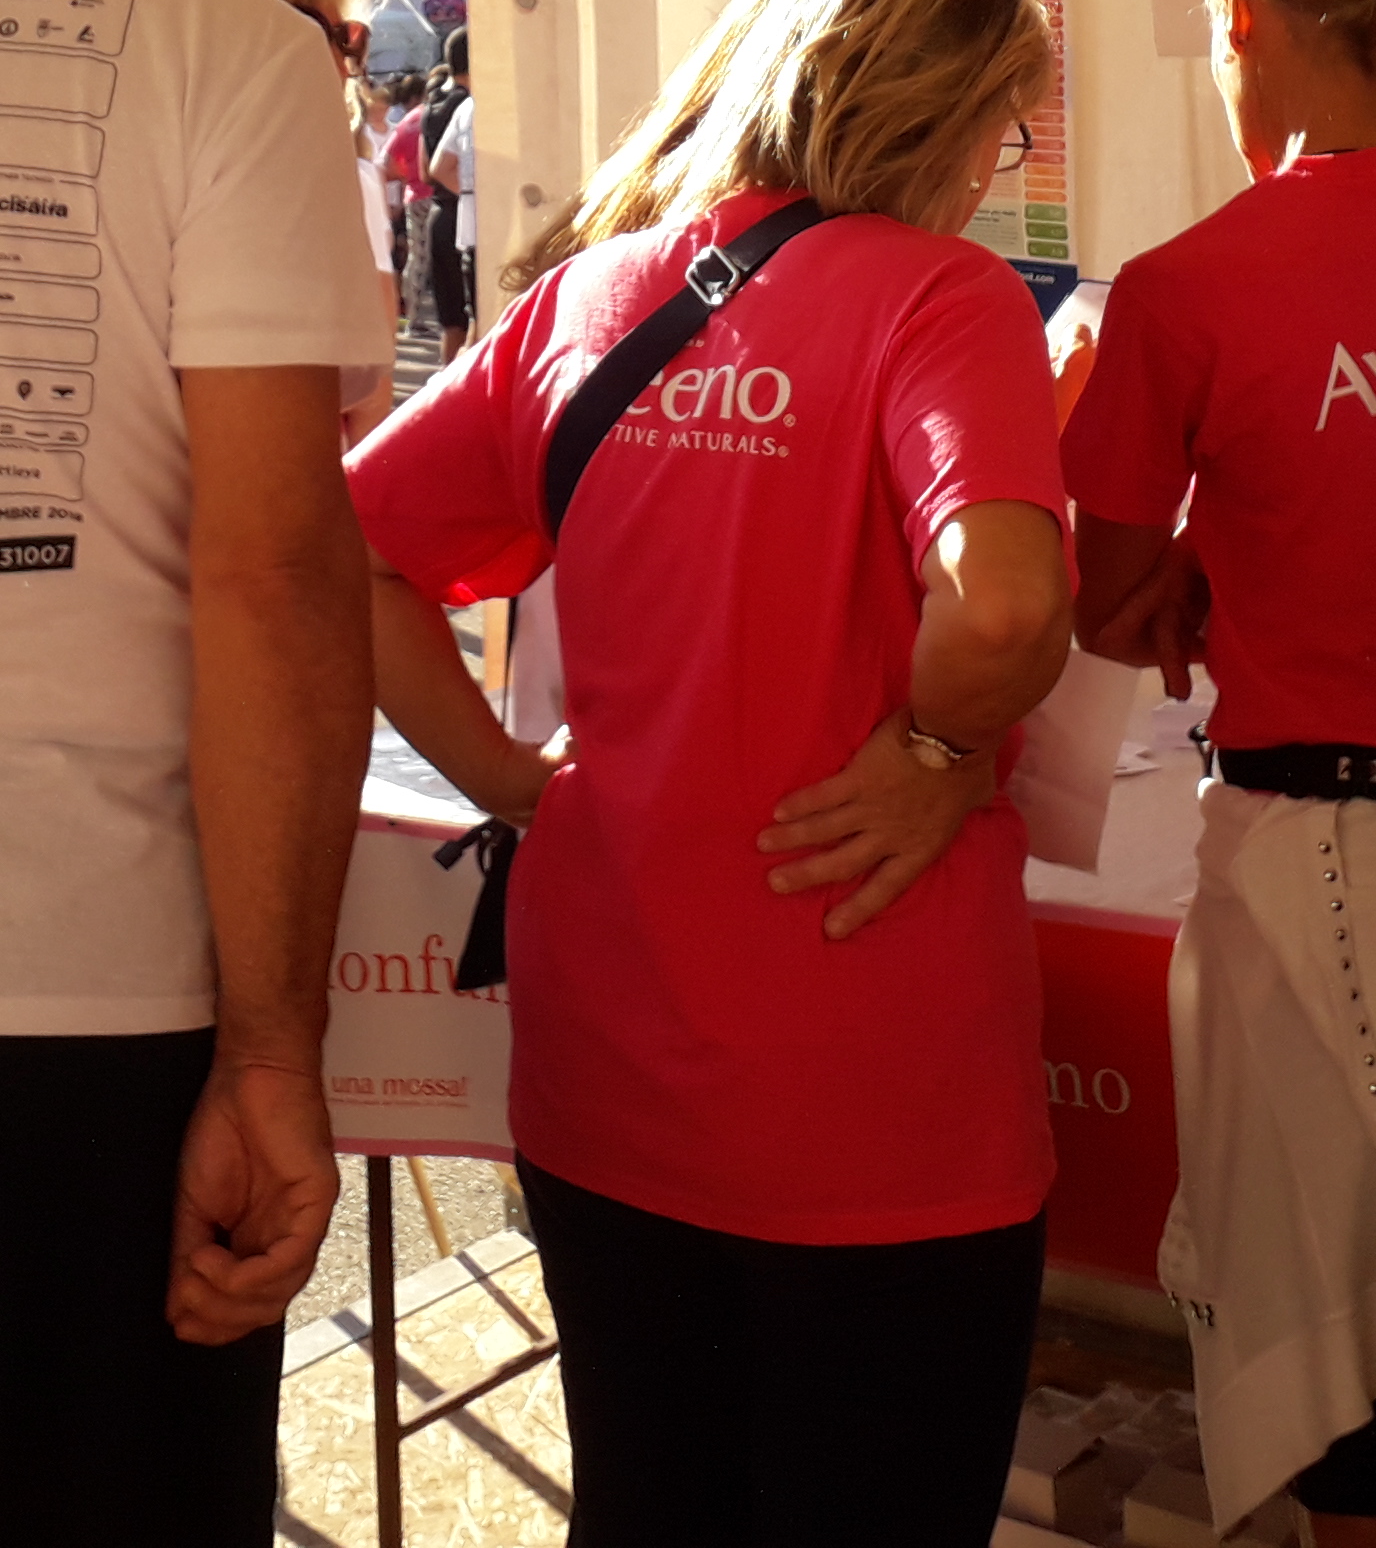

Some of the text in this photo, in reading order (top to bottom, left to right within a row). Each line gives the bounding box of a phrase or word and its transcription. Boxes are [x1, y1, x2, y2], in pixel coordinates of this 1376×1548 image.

[625, 363, 792, 424] eno
[604, 424, 777, 456] TIVE NATURALS
[331, 1075, 374, 1094] una
